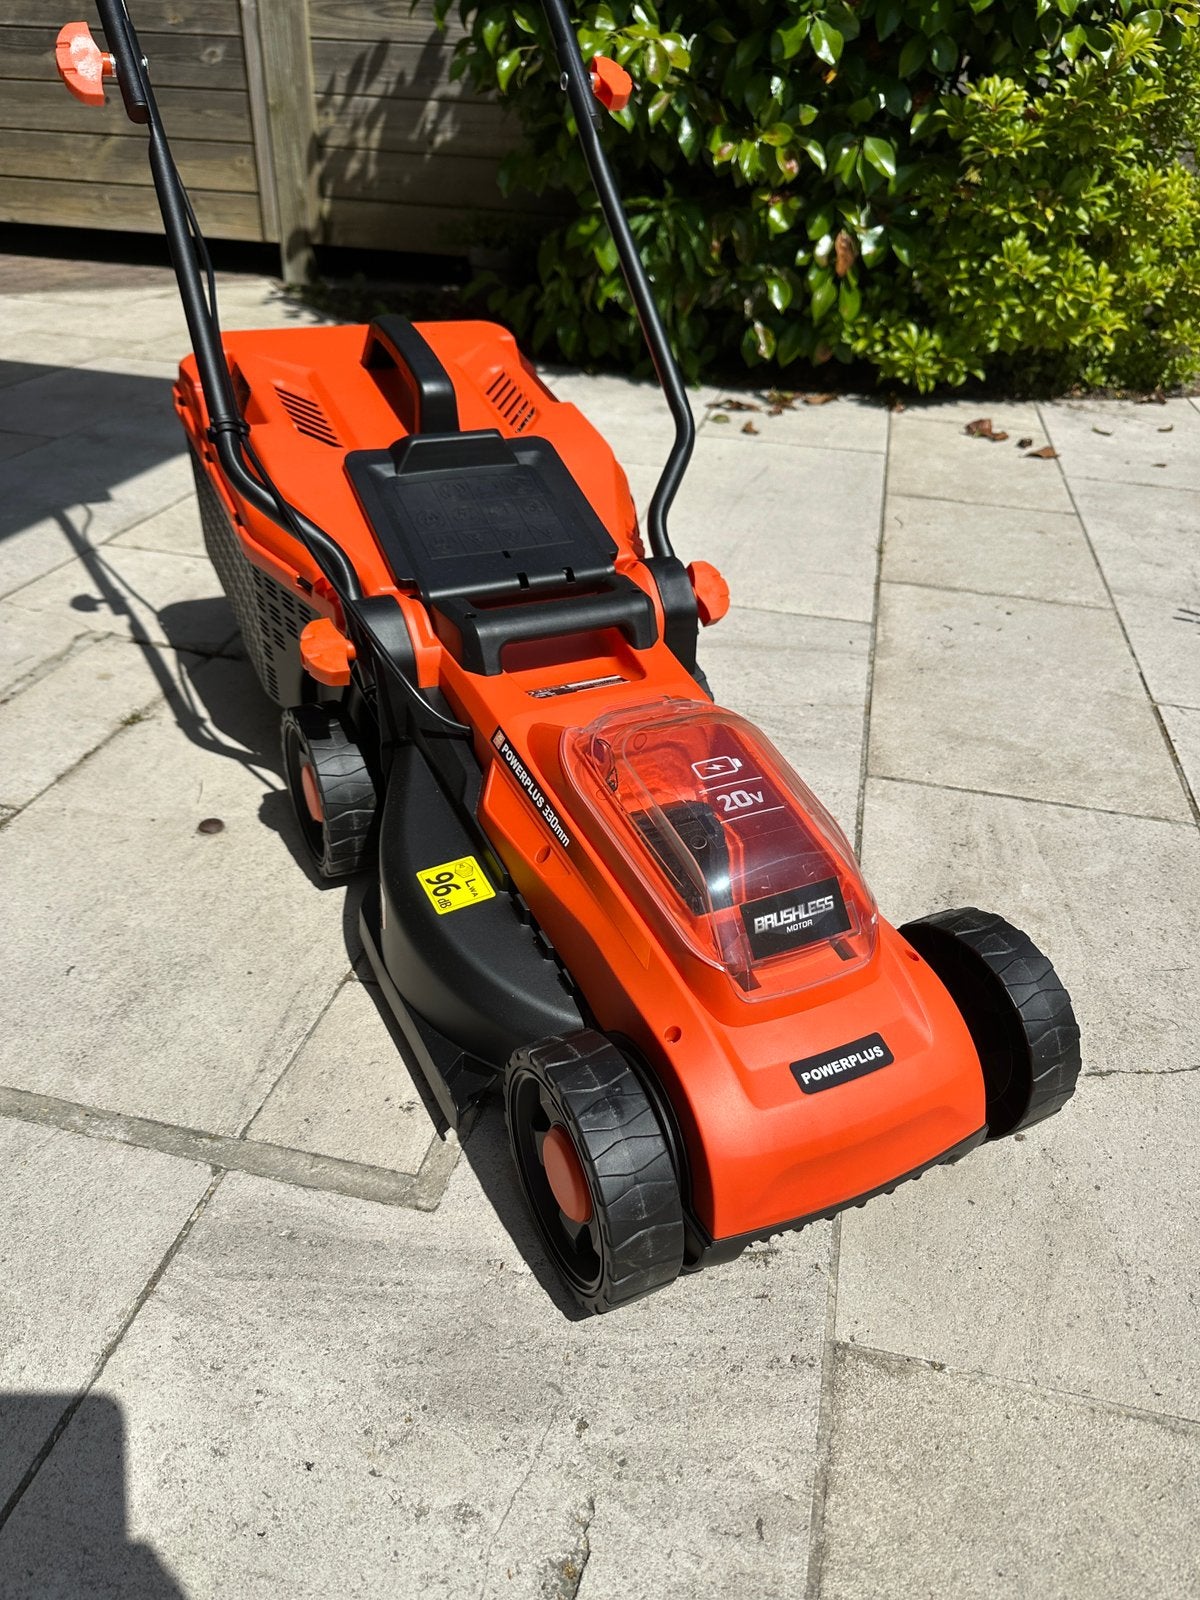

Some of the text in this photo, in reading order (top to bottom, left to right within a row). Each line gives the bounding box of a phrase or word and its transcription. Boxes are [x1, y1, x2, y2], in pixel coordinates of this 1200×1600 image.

[501, 743, 570, 847] POWERPLUS 330mm
[425, 872, 462, 897] 96
[754, 895, 834, 934] BRUSHLESS
[786, 919, 813, 933] MOTOR
[800, 1045, 884, 1085] POWERPLUS
